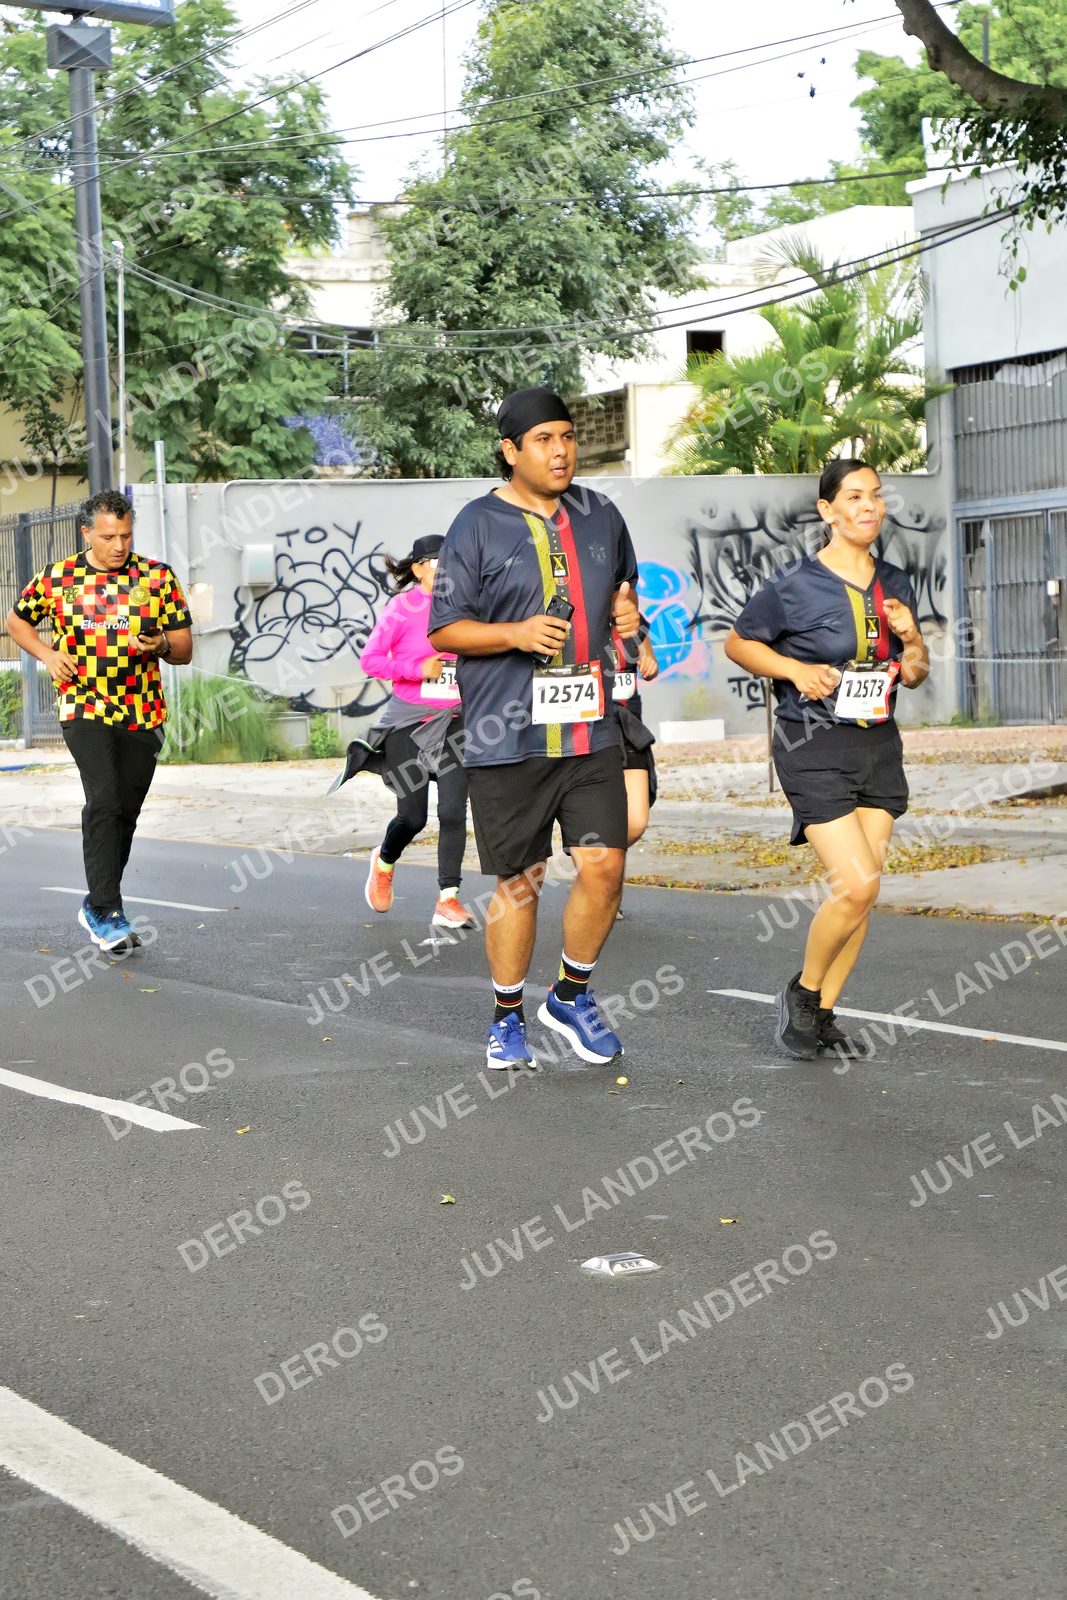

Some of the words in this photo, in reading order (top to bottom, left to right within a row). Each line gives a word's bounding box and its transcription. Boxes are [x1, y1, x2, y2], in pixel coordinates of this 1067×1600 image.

[275, 520, 363, 554] TOY
[80, 618, 130, 630] Electrolit
[538, 682, 595, 704] 12574
[845, 679, 885, 698] 12573
